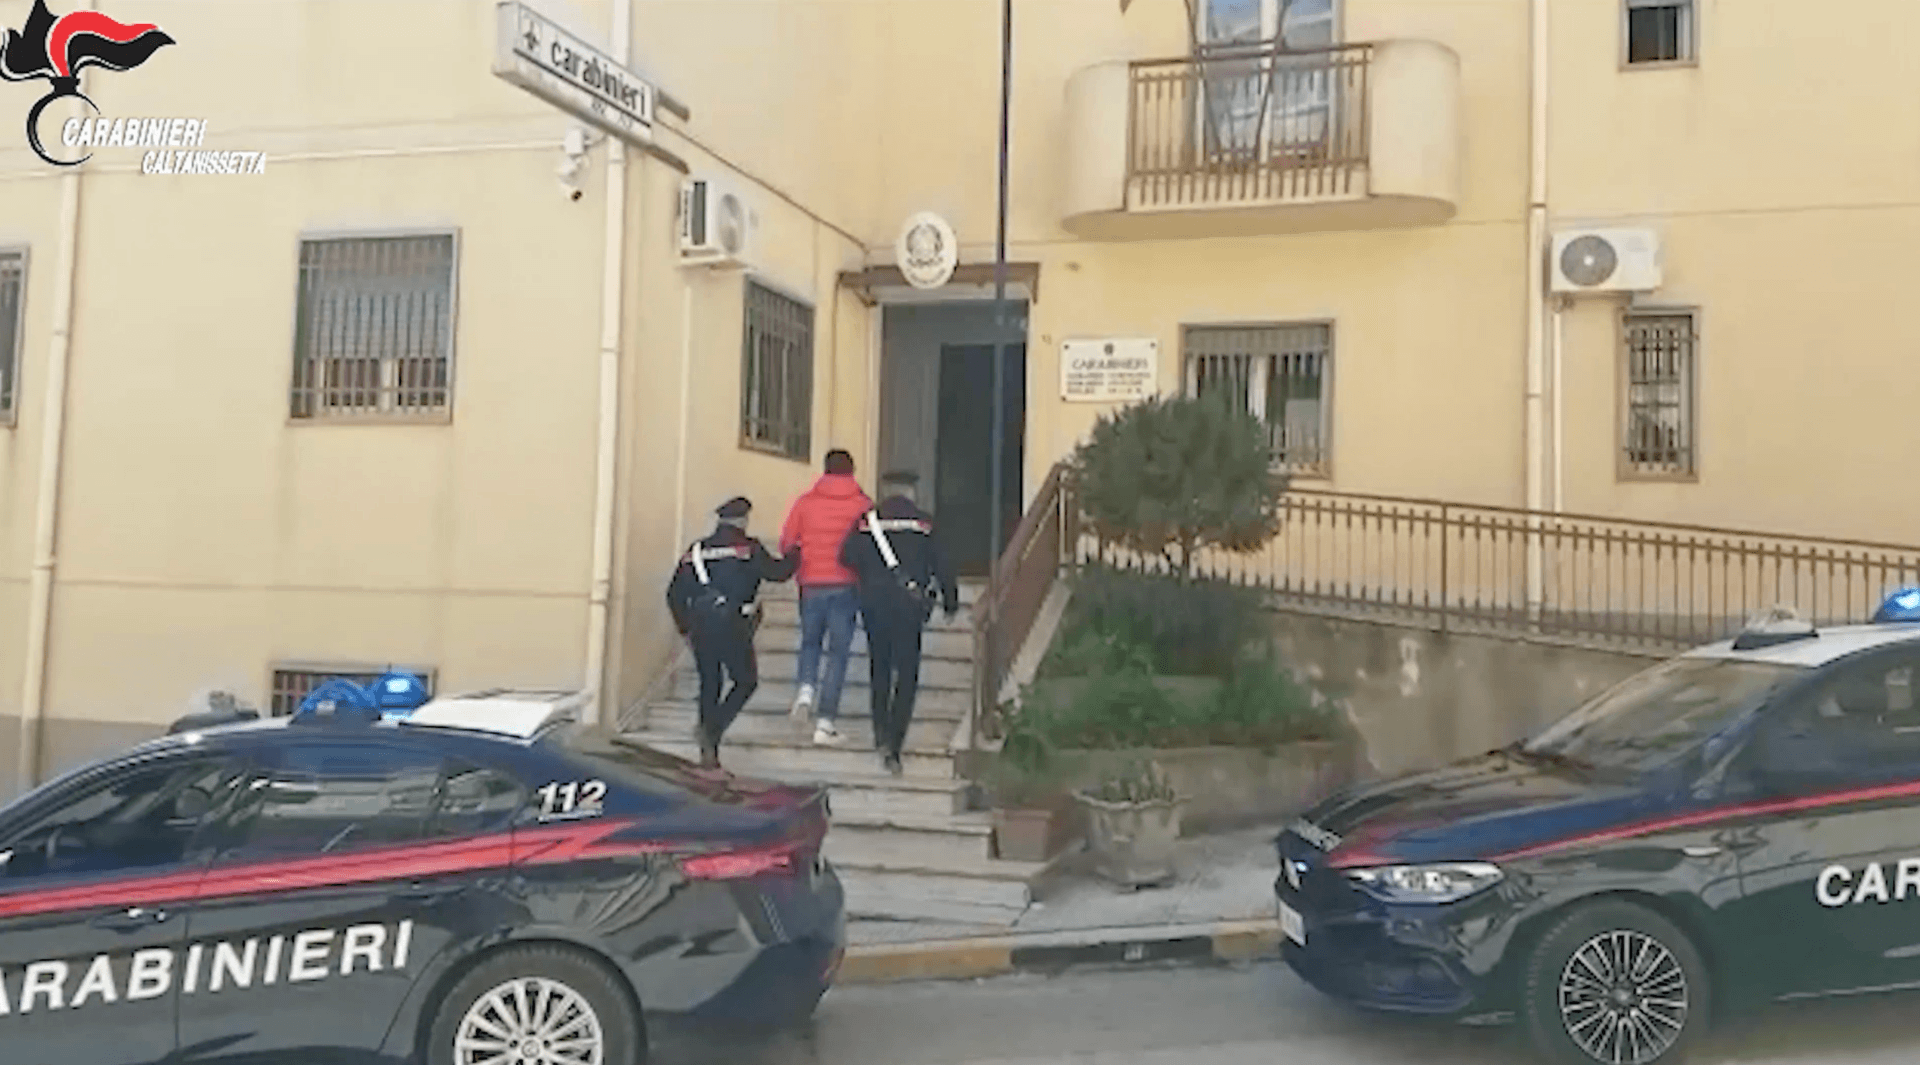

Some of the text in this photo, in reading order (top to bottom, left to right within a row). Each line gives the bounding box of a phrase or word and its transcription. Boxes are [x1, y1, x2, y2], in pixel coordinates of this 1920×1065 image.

[551, 41, 645, 116] carabinieri
[538, 780, 607, 815] 112
[1816, 857, 1920, 906] CAR
[0, 919, 413, 1016] RABINIERI
